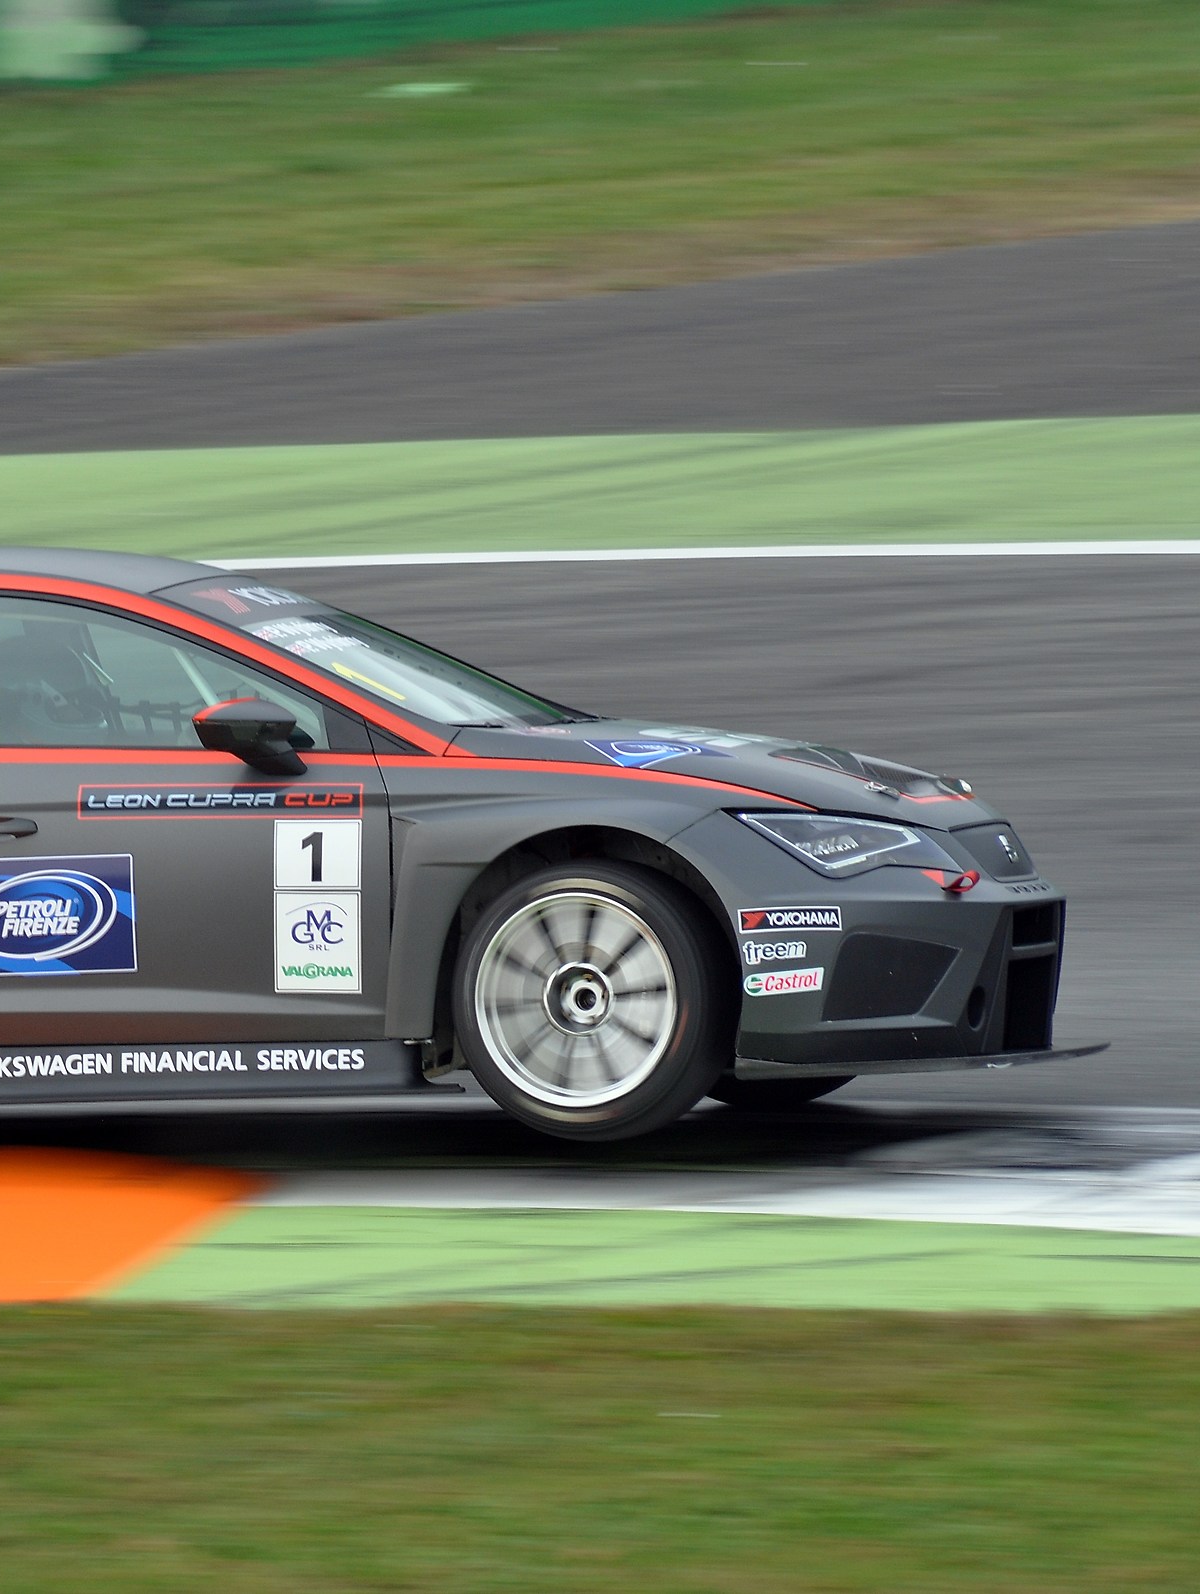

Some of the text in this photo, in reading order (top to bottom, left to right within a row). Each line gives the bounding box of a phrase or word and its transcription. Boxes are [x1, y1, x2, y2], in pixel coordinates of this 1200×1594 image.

[87, 792, 354, 808] LEON CUPRA CUP
[301, 831, 324, 882] 1
[1, 916, 80, 939] FIRENZE
[765, 911, 840, 927] YOKOHAMA
[308, 943, 329, 952] SRL
[745, 941, 806, 963] freem
[281, 962, 354, 979] VALGRANA
[764, 971, 818, 992] Castrol
[120, 1050, 248, 1074] FINANCIAL
[256, 1048, 365, 1072] SERVICES
